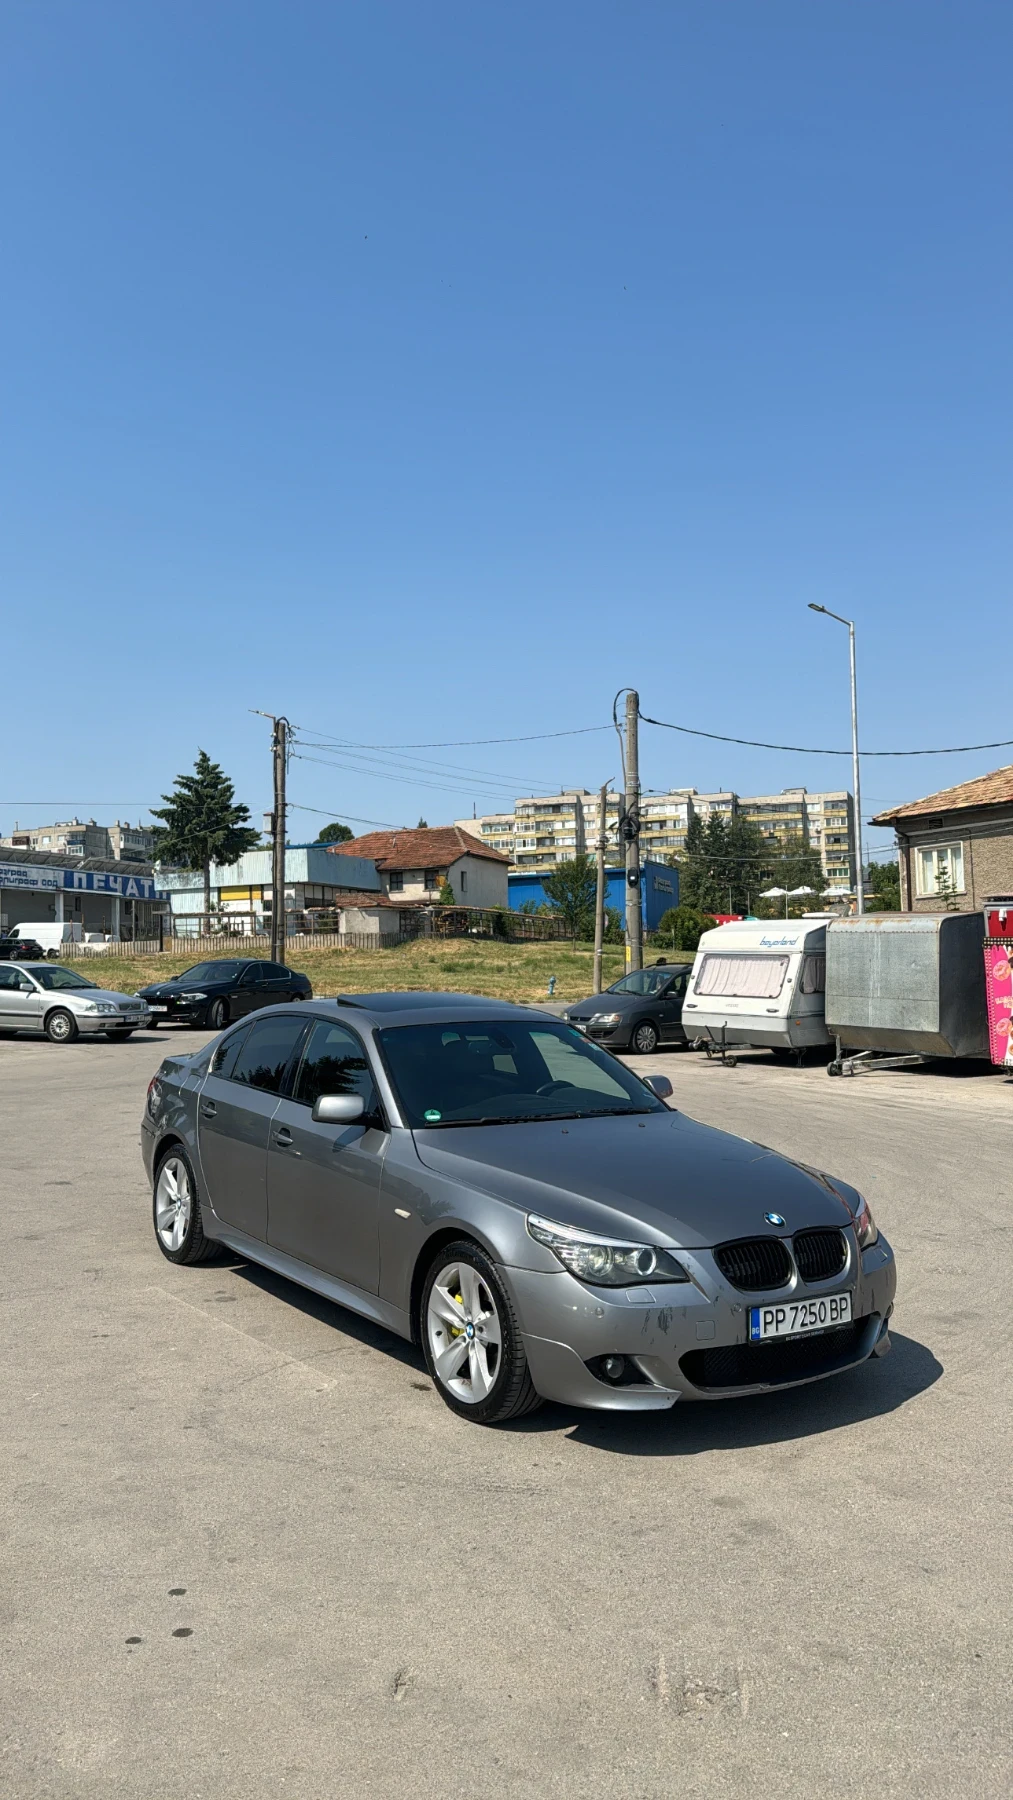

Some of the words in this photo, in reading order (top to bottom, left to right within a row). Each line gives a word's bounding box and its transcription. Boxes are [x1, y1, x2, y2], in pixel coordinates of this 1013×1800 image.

[752, 1327, 760, 1335] BG
[763, 1309, 786, 1334] PP
[789, 1301, 827, 1330] 7250
[829, 1297, 848, 1322] BP
